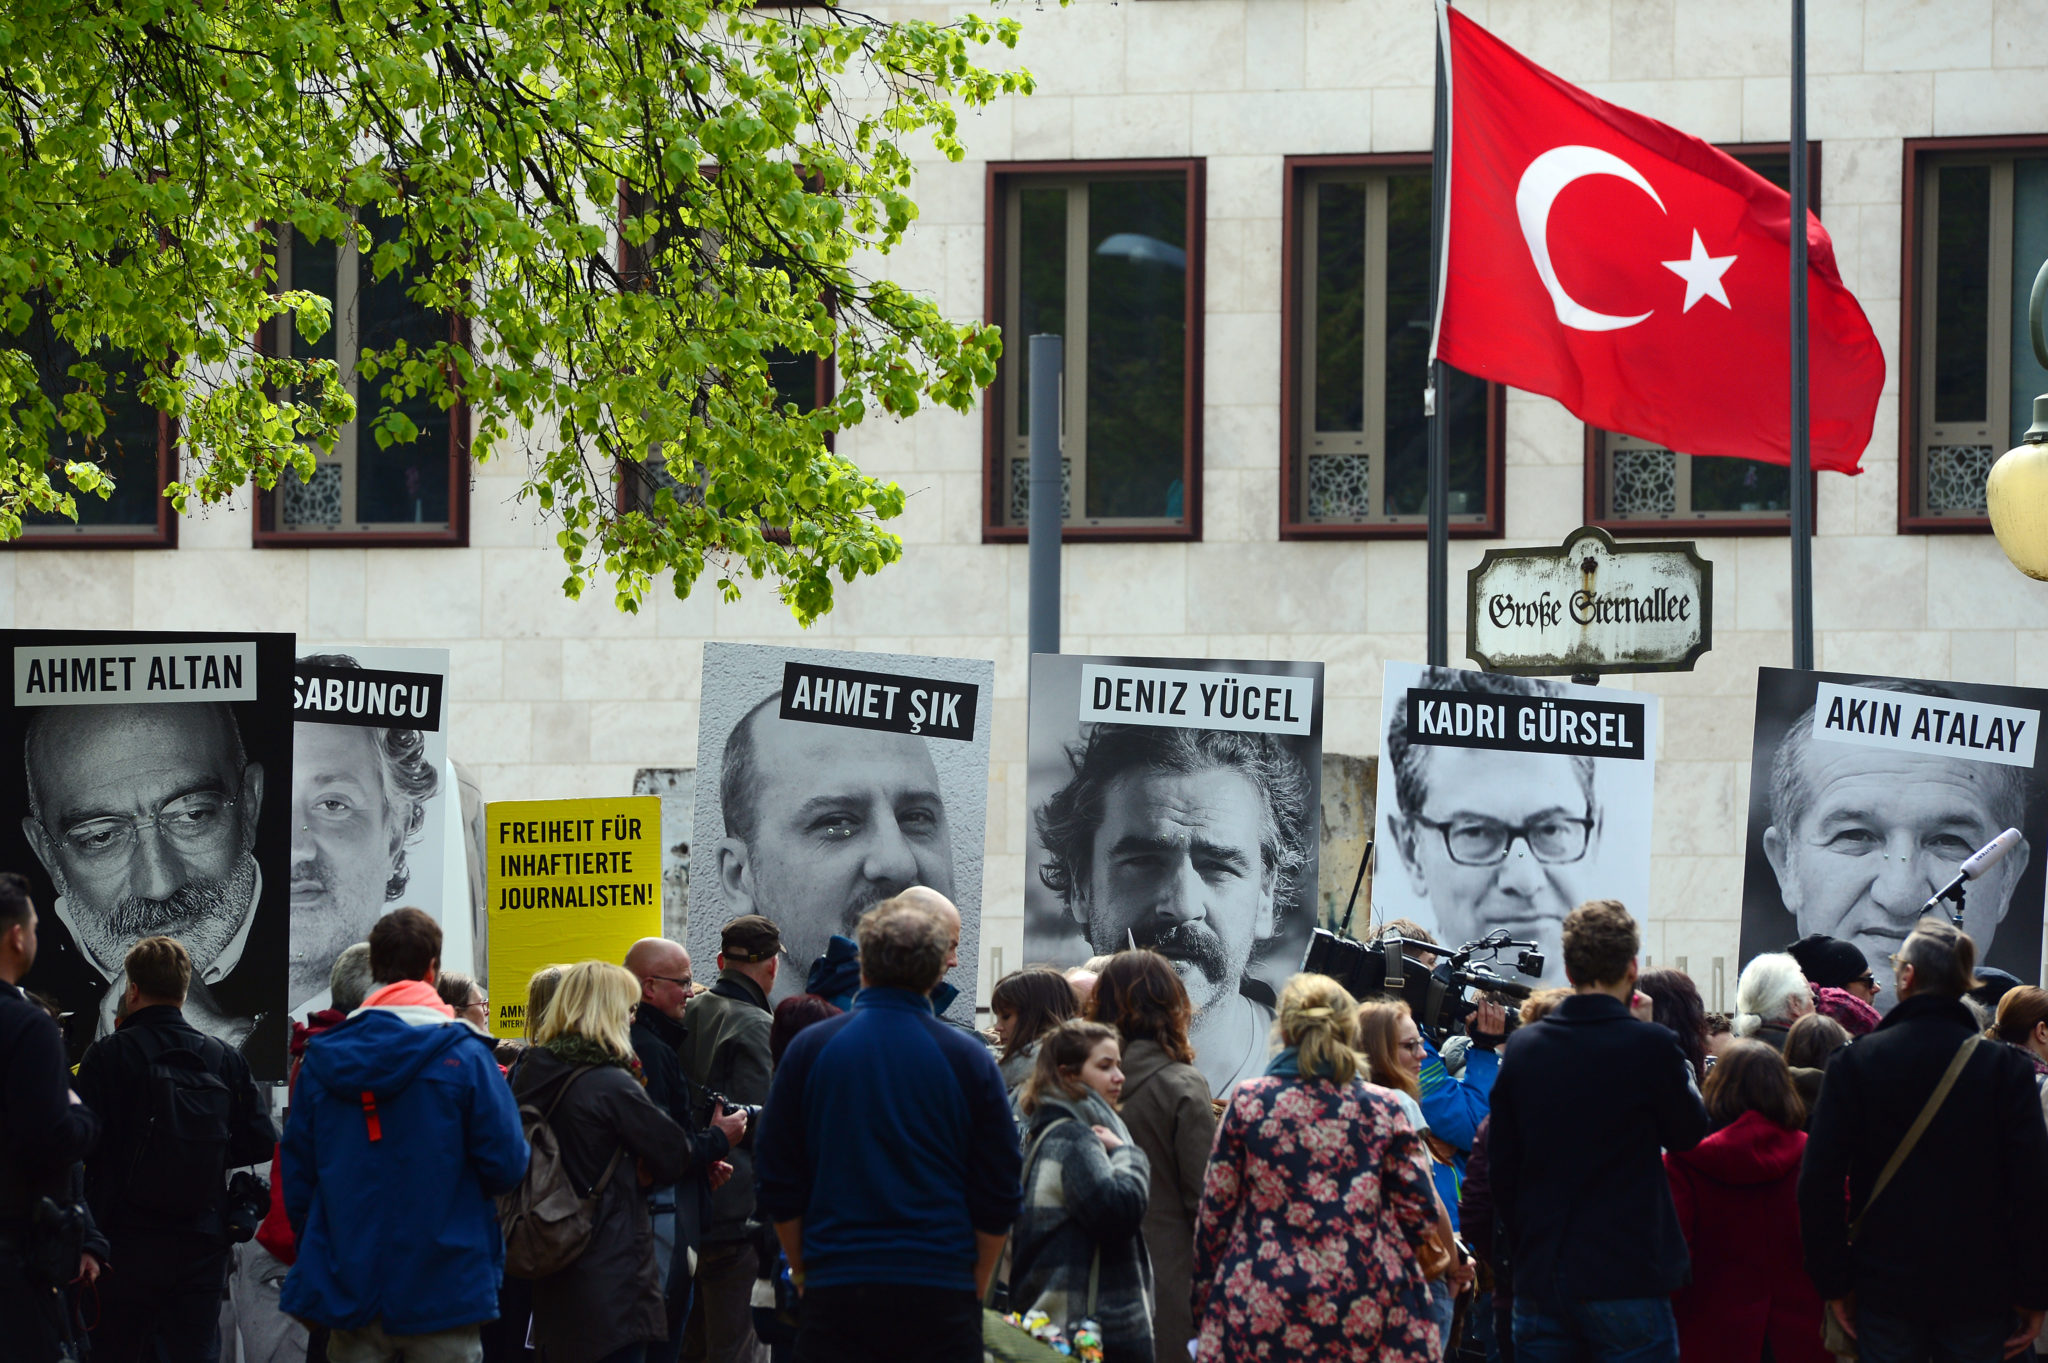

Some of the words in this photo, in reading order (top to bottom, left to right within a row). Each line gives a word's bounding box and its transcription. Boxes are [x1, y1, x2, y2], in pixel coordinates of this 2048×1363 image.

[1488, 591, 1562, 635] Große
[1569, 587, 1691, 626] Sternallee
[26, 655, 136, 694] AHMET
[147, 654, 242, 691] ALTAN
[293, 675, 430, 719] SABUNCU
[791, 675, 901, 720] AHMET
[908, 689, 962, 734] ŞIK
[1092, 676, 1188, 716] DENIZ
[1199, 677, 1300, 723] YÜCEL
[1417, 699, 1506, 739] KADRI
[1518, 701, 1634, 748] GÜRSEL
[1825, 696, 1902, 738] AKIN
[1910, 707, 2026, 754] ATALAY
[500, 819, 594, 844] FREIHEIT
[601, 814, 642, 841] FÜR
[501, 851, 633, 877] INHAFTIERTE
[499, 883, 653, 910] JOURNALISTEN!
